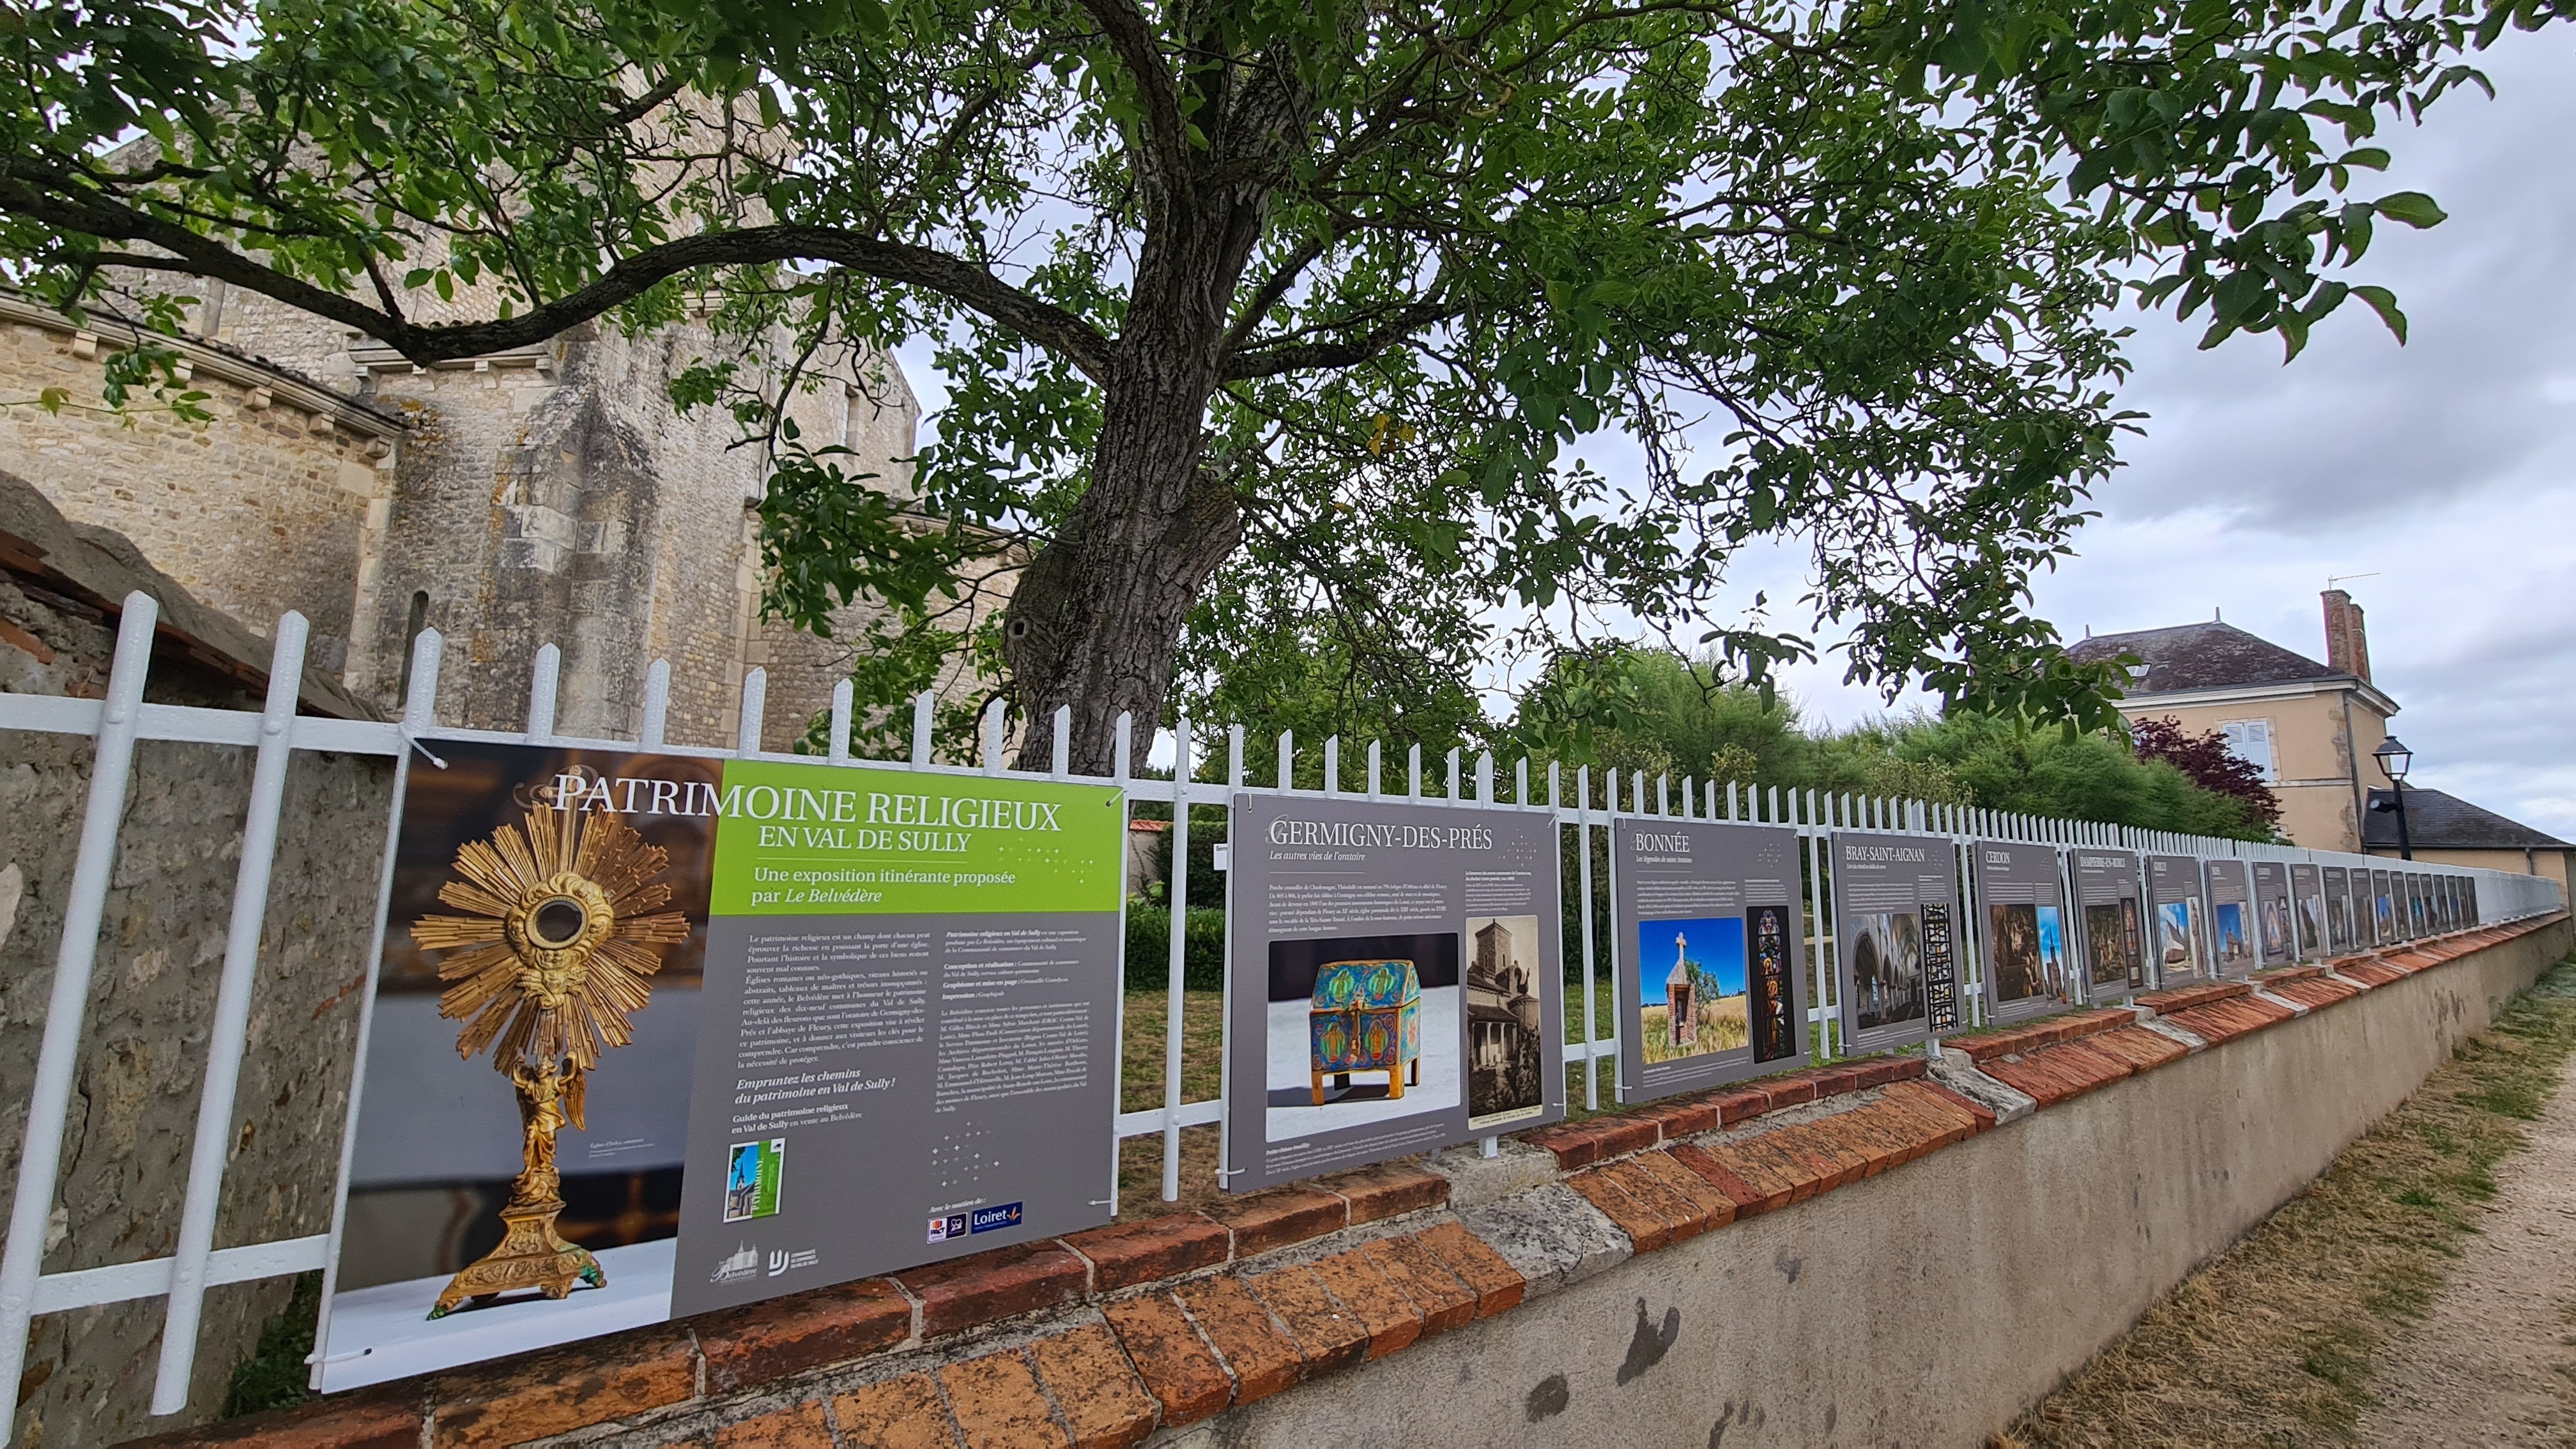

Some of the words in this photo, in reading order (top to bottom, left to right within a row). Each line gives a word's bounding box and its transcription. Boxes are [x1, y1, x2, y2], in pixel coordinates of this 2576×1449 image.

[553, 774, 857, 823] PATRIMOINE
[866, 793, 1062, 832] RELIGIEUX
[758, 825, 797, 847] EN
[802, 827, 852, 849] VAL
[857, 829, 893, 850] DE
[898, 831, 972, 852] SULLY
[1270, 820, 1492, 850] GERMIGNY-DES-PRÉS
[1635, 831, 1690, 853] BONNÉE
[1269, 850, 1283, 860] Les
[1284, 851, 1307, 861] autres
[1308, 852, 1322, 861] vies
[1324, 852, 1333, 861] de
[1334, 852, 1365, 861] l'oratoire
[1845, 845, 1925, 862] BRAY-SAINT-AIGNAN
[1986, 851, 2010, 864] CERDON
[754, 868, 789, 882] Une
[793, 870, 875, 885] exposition
[880, 869, 950, 884] itinérante
[953, 871, 1016, 886] proposée
[751, 890, 781, 907] par
[785, 889, 804, 903] Le
[808, 889, 882, 903] Belvédère
[761, 935, 799, 944] patrimoine
[801, 933, 830, 942] religieux
[854, 932, 875, 940] champ
[748, 946, 779, 954] éprouver
[830, 953, 867, 961] symbolique
[746, 975, 770, 985] Églises
[817, 972, 866, 981] néo-gothiques,
[742, 1007, 774, 1016] religieux
[795, 1003, 826, 1011] dix-neuf
[850, 1020, 883, 1029] exposition
[749, 1037, 791, 1048] patrimoine,
[746, 1058, 777, 1067] nécessité
[789, 1055, 818, 1065] protéger.
[736, 1075, 799, 1091] Empruntez
[801, 1073, 815, 1084] les
[816, 1069, 862, 1082] chemins
[735, 1094, 751, 1105] du
[752, 1087, 816, 1105] patrimoine
[817, 1086, 831, 1094] en
[832, 1083, 849, 1094] Val
[850, 1081, 864, 1091] de
[733, 1114, 758, 1123] Guide
[758, 1112, 770, 1121] du
[770, 1108, 815, 1120] patrimoine
[816, 1103, 848, 1114] religieux
[768, 1120, 789, 1130] Sully
[830, 1112, 862, 1122] Belvédère
[974, 1209, 1006, 1225] Loiret
